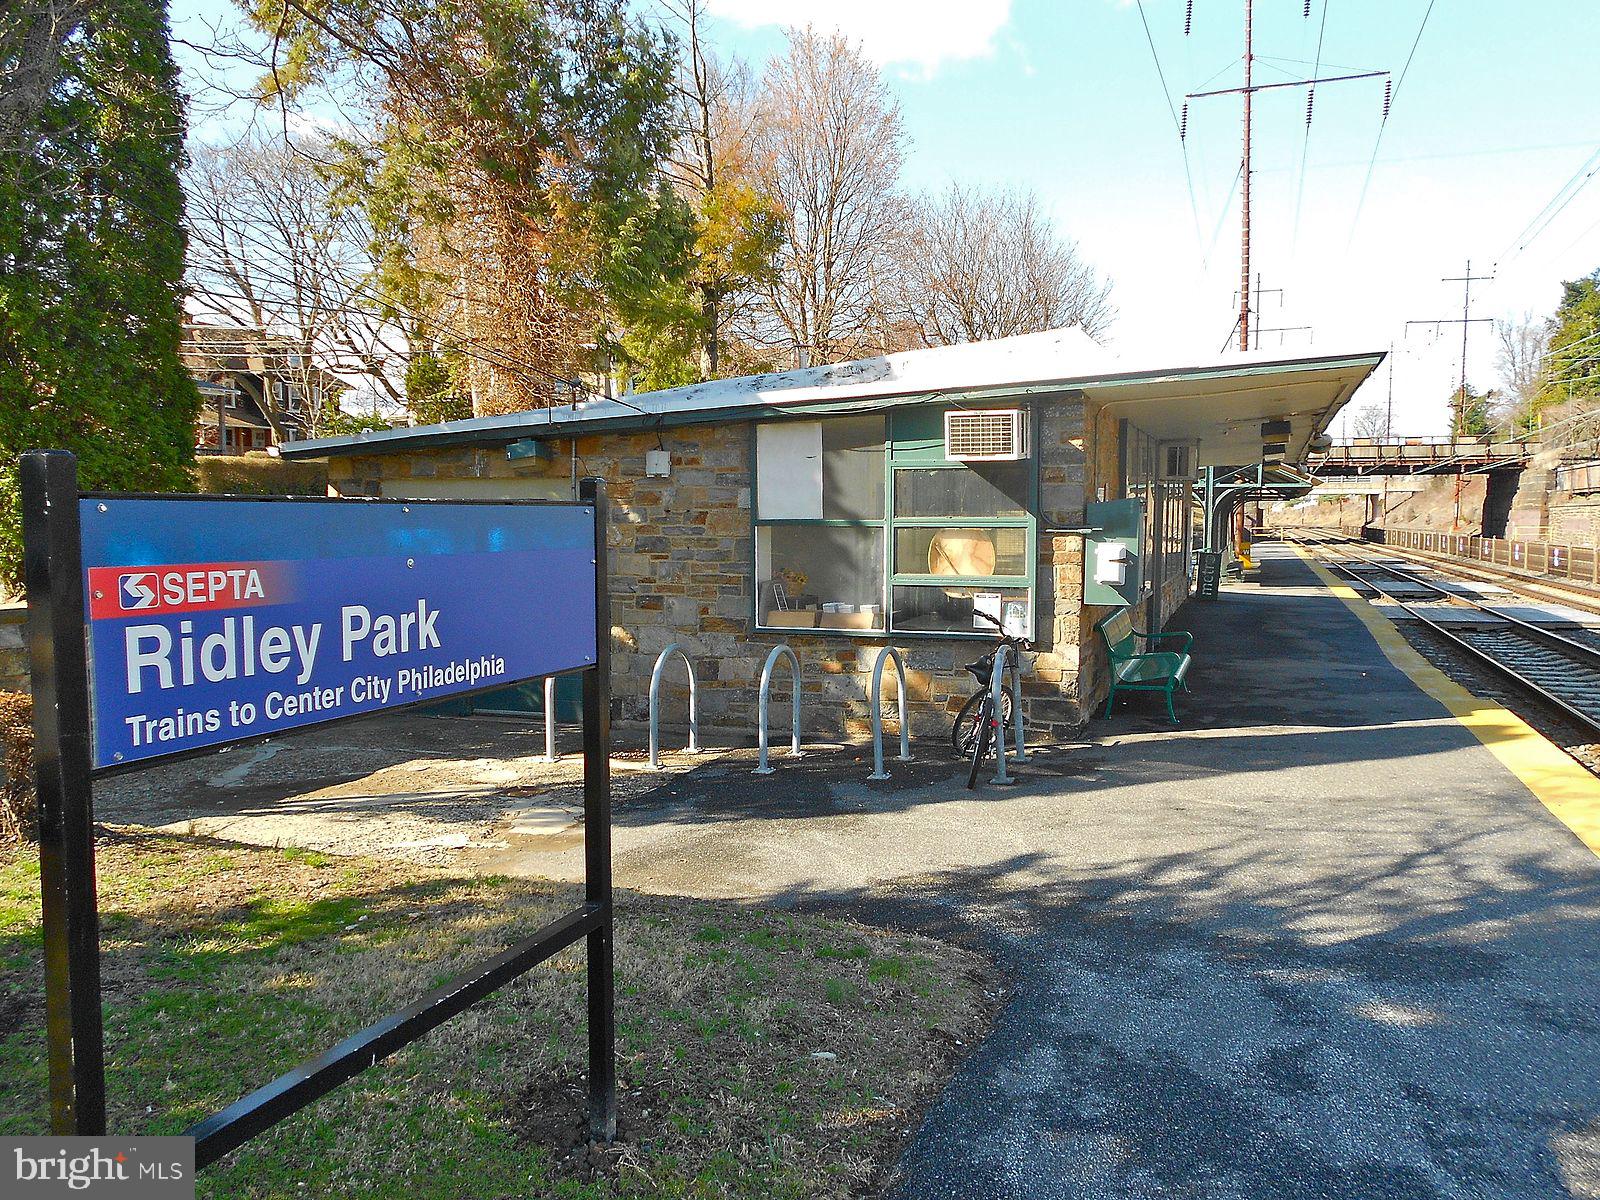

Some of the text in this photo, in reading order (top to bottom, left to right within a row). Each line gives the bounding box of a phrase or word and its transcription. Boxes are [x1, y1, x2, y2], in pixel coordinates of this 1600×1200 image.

[163, 569, 265, 605] SEPTA
[125, 598, 441, 693] Ridley Park
[125, 653, 505, 746] Trains to Center City Philadelphia
